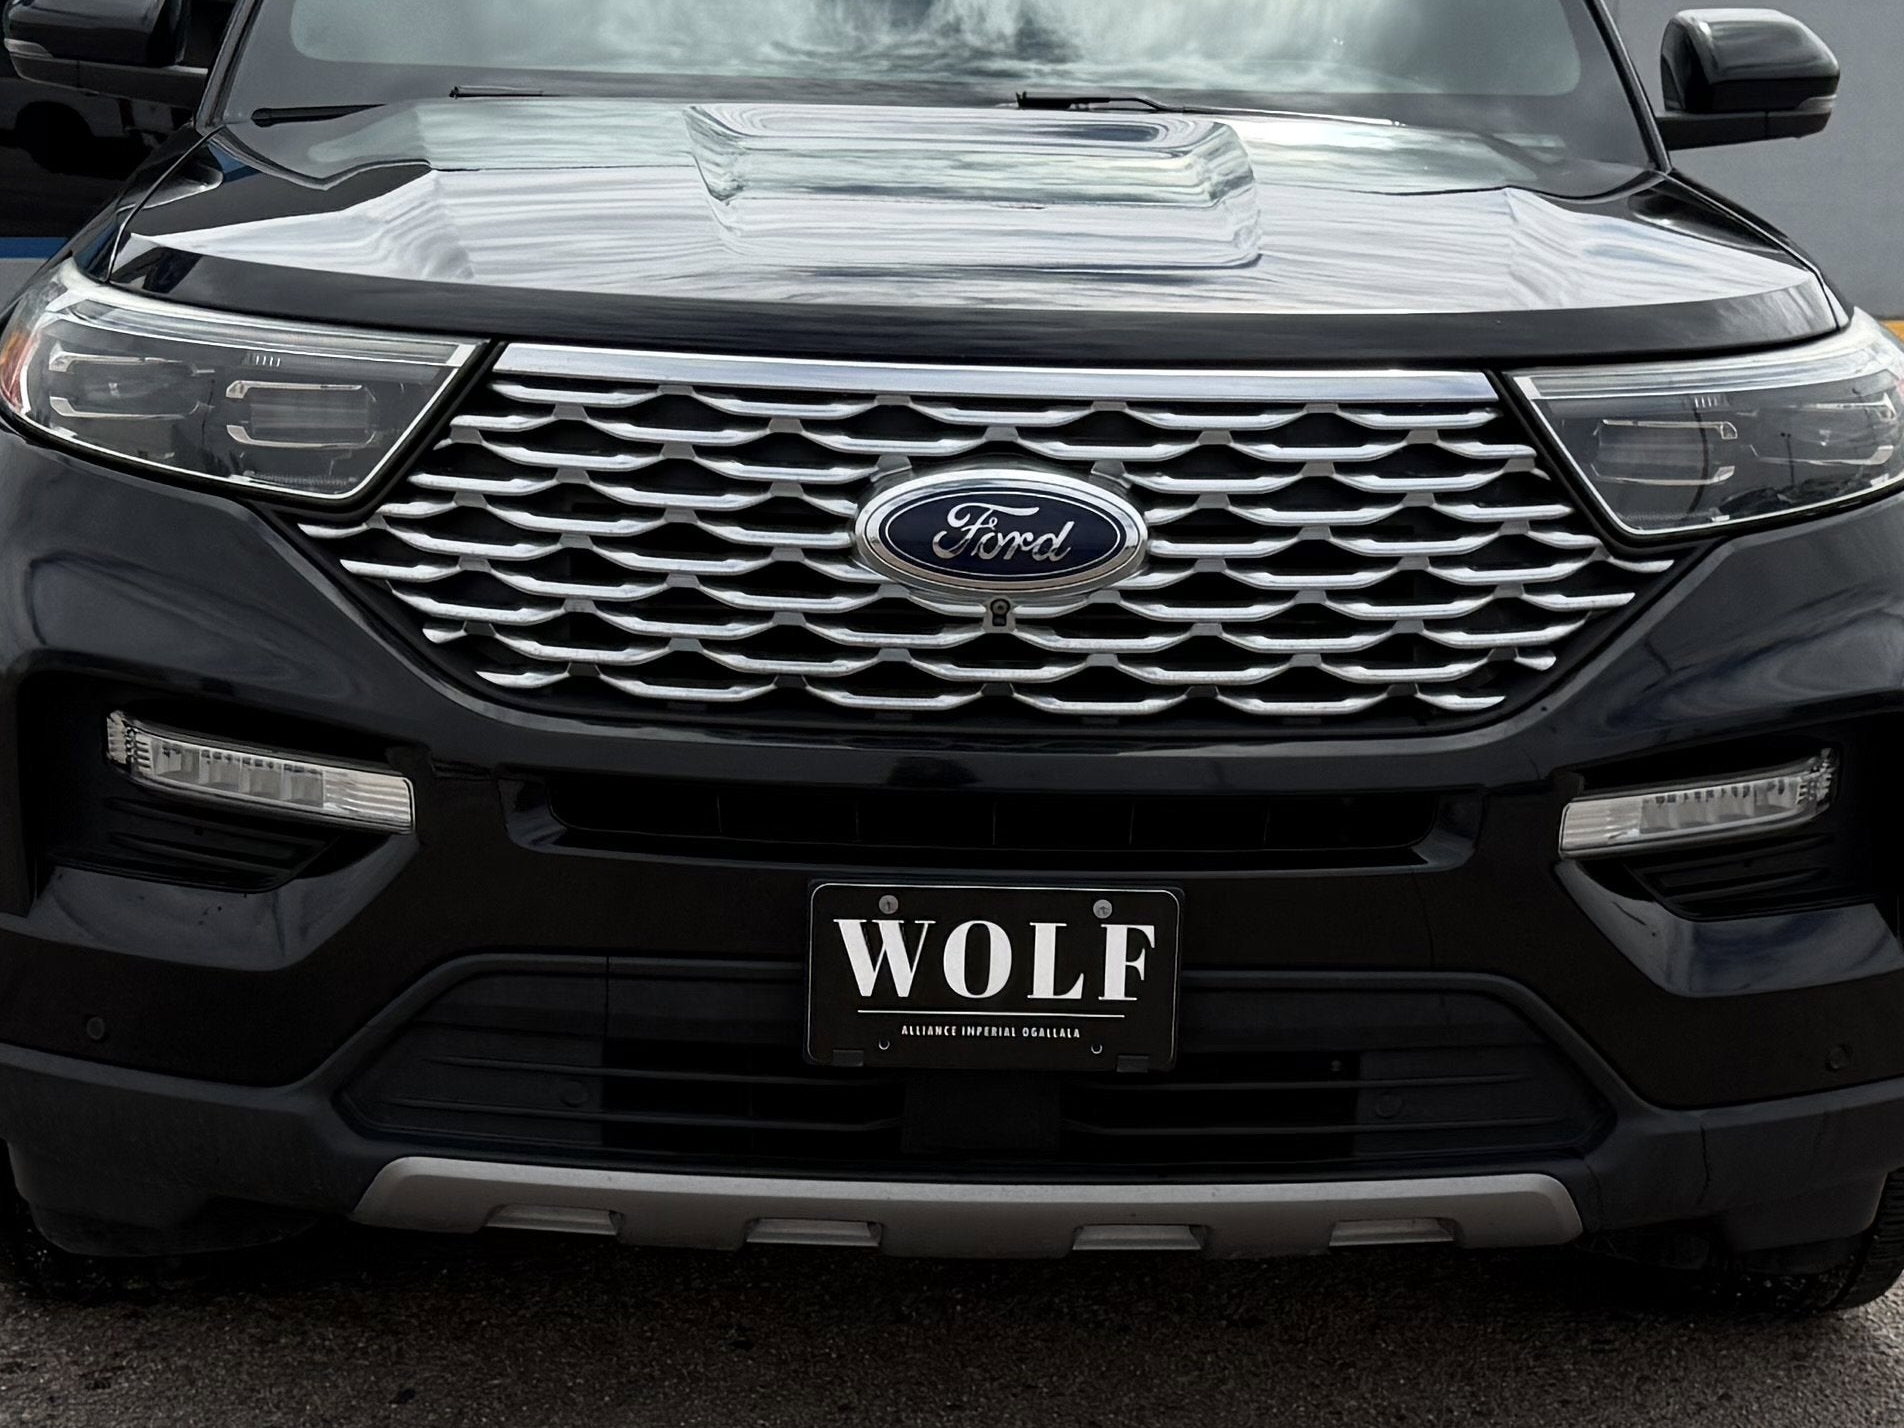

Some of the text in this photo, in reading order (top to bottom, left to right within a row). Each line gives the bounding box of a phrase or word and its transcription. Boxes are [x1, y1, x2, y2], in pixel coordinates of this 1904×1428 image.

[932, 502, 1075, 562] Ford
[832, 918, 1157, 1001] WOLF
[901, 1025, 957, 1036] ALLIANCE
[1022, 1027, 1080, 1039] OGALLALA
